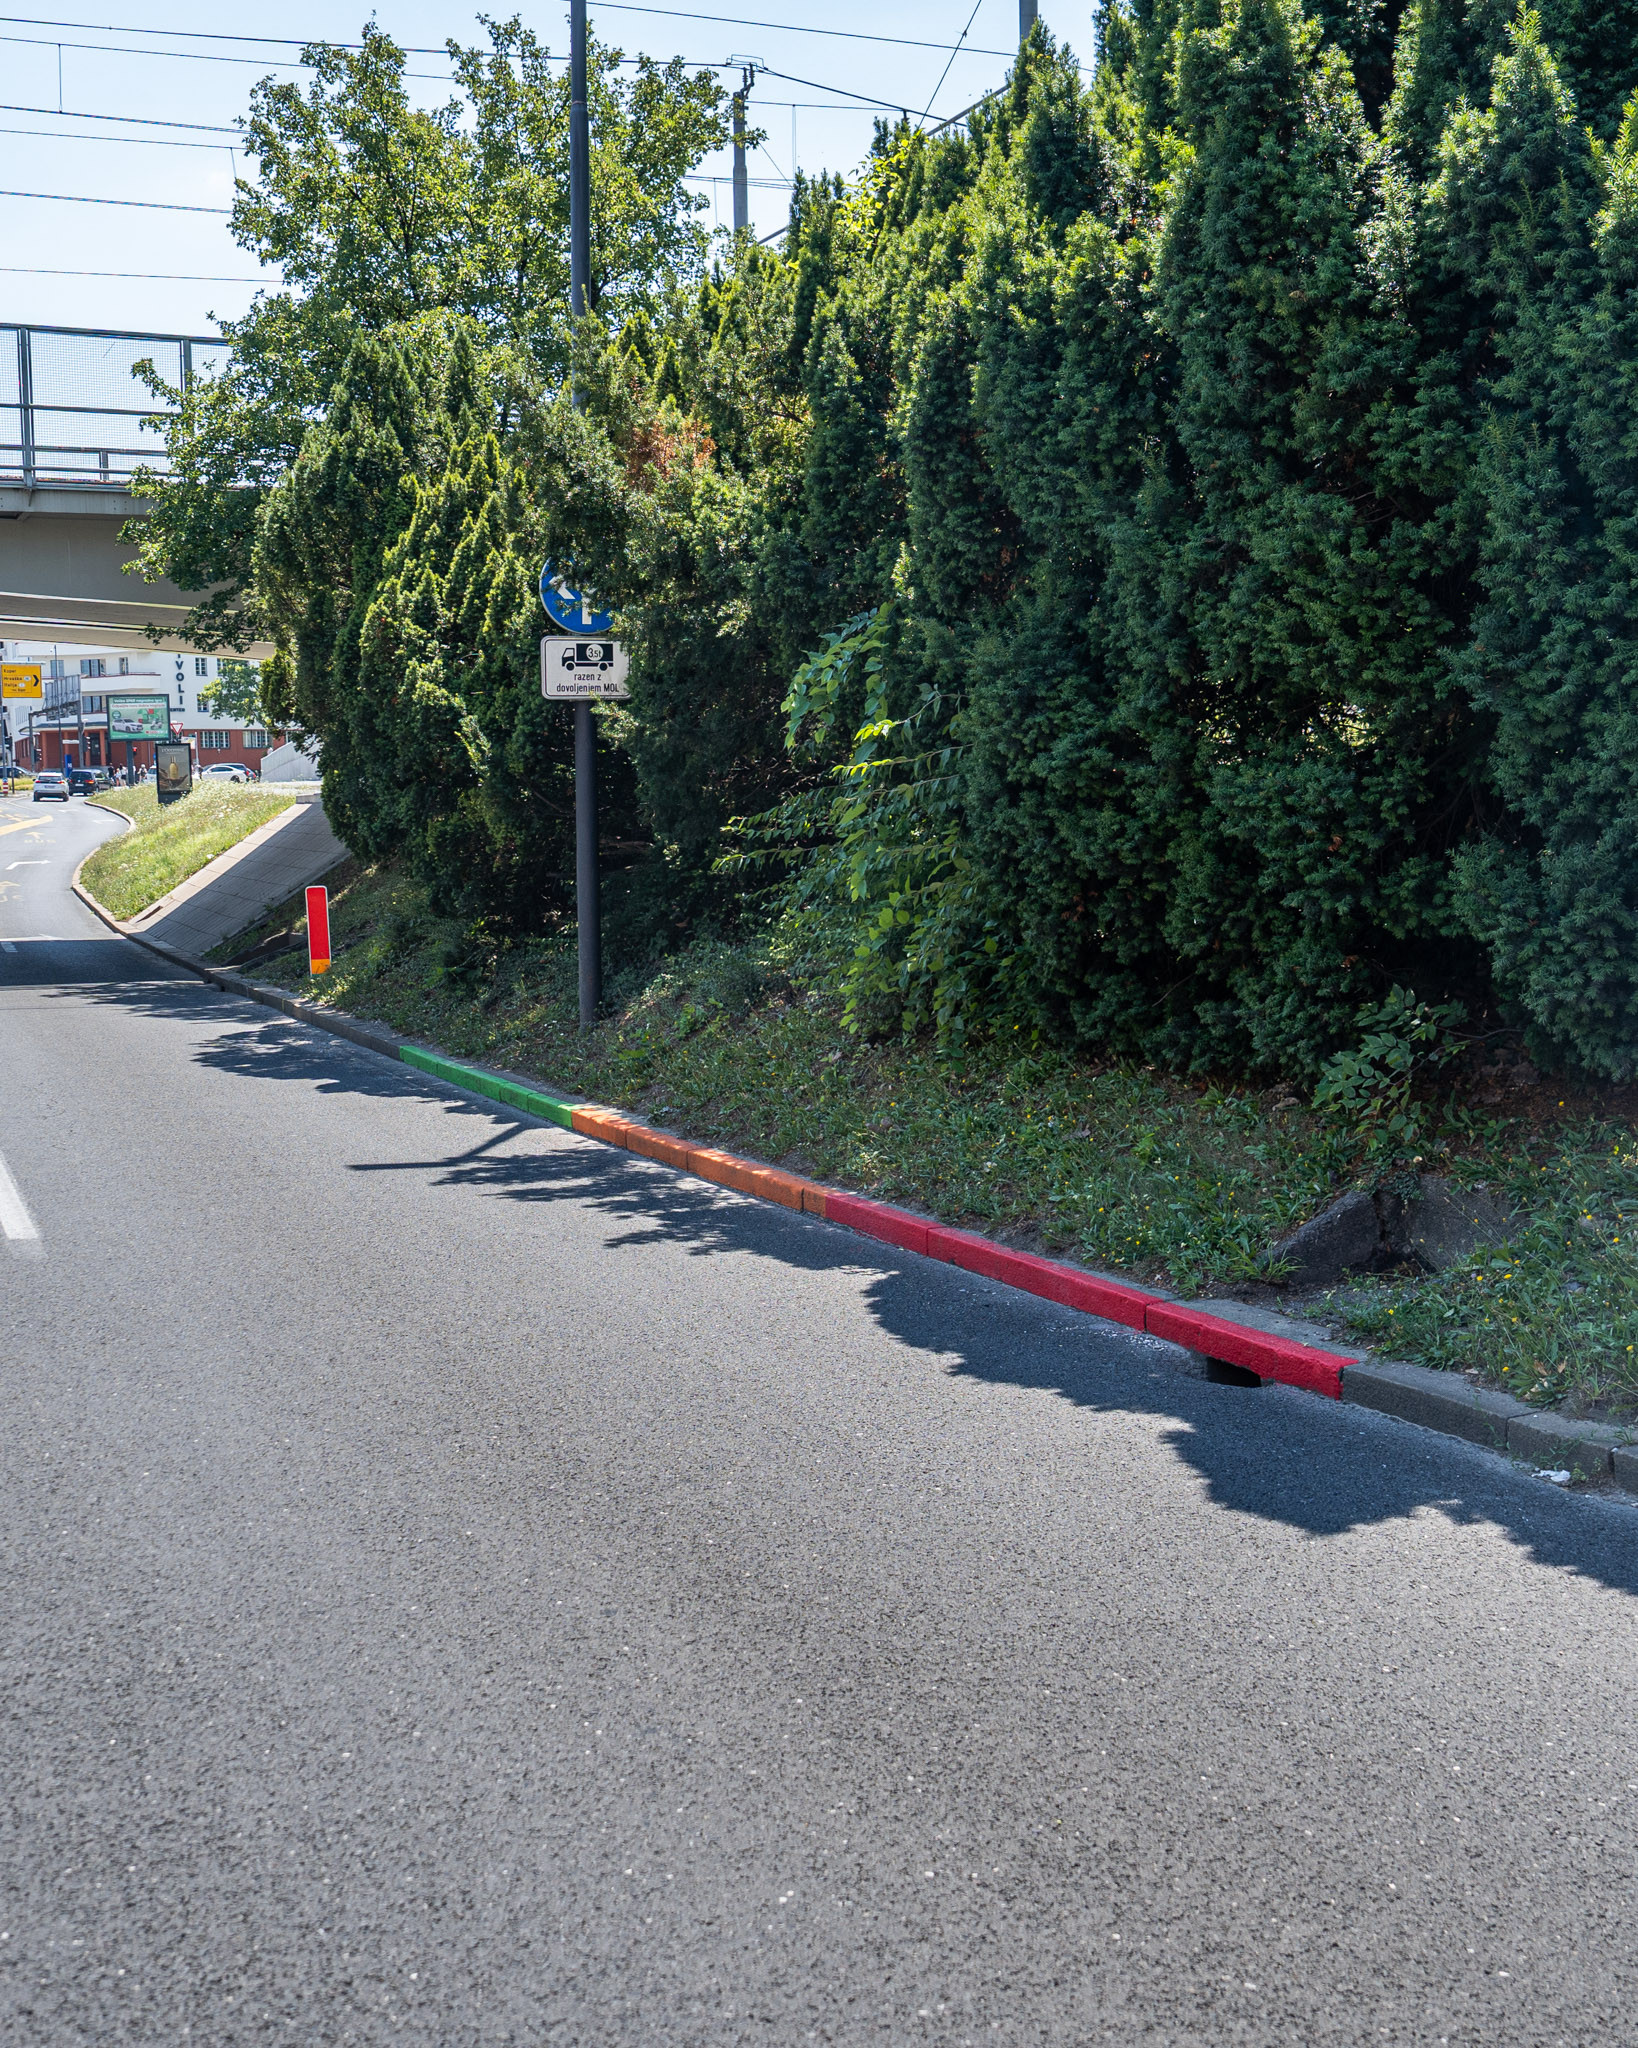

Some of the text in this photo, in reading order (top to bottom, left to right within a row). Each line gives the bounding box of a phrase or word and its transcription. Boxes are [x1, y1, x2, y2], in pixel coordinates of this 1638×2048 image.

[574, 673, 595, 681] razen
[556, 683, 620, 695] dovoljenjem MOL
